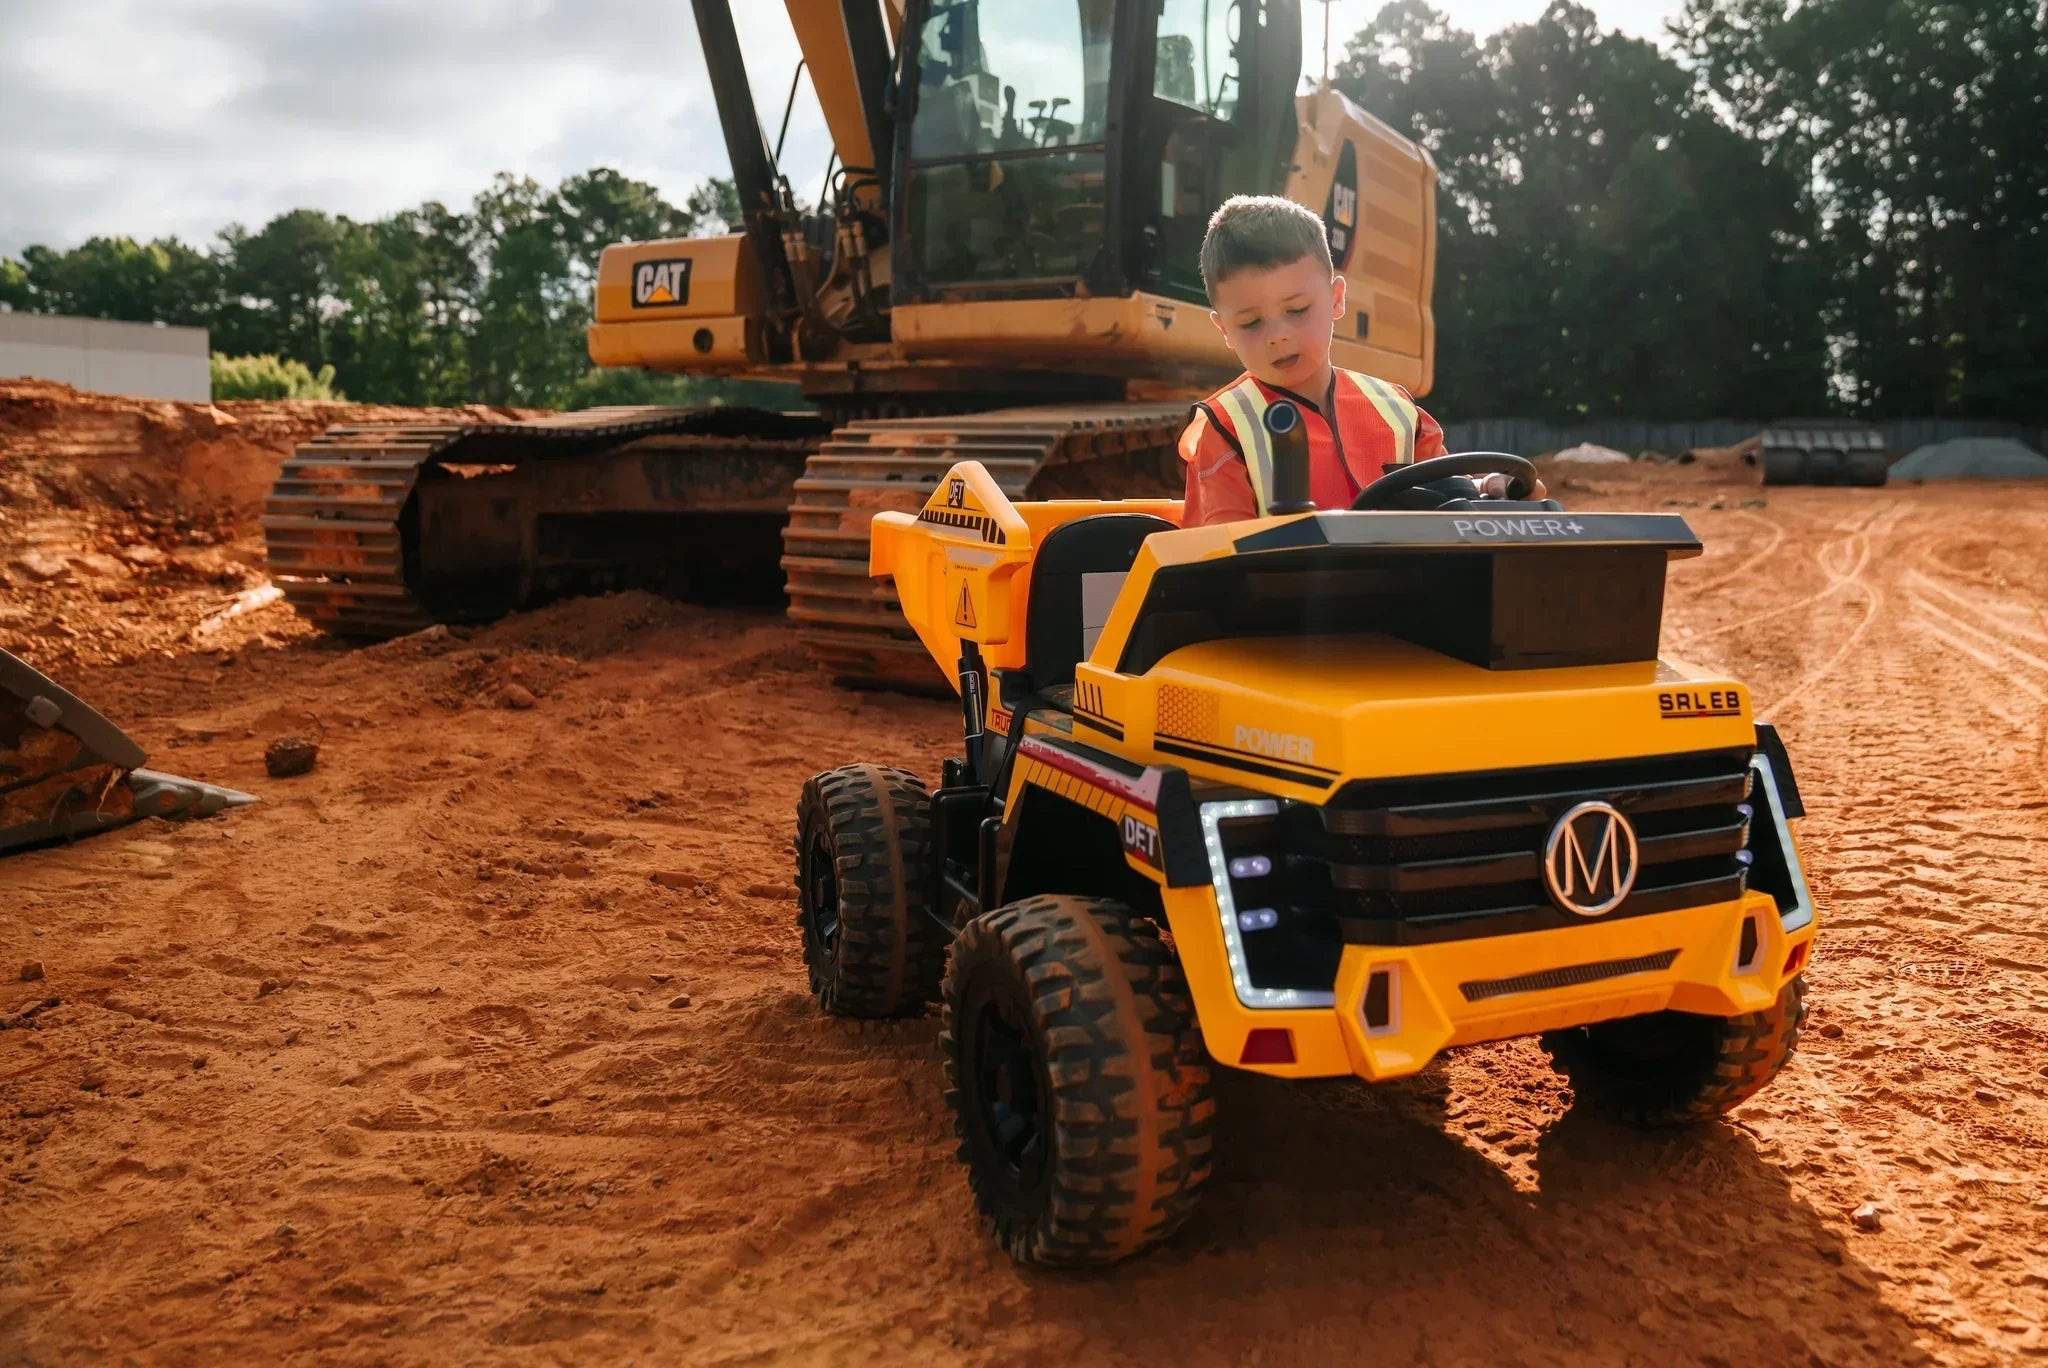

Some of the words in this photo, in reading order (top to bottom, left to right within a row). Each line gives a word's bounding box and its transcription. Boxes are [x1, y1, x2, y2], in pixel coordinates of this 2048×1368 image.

[1333, 182, 1356, 227] CAT
[636, 262, 686, 303] CAT
[992, 707, 1013, 733] TRUC
[1657, 691, 1741, 712] SRLEB
[1234, 724, 1315, 767] POWER
[1123, 814, 1157, 857] DET
